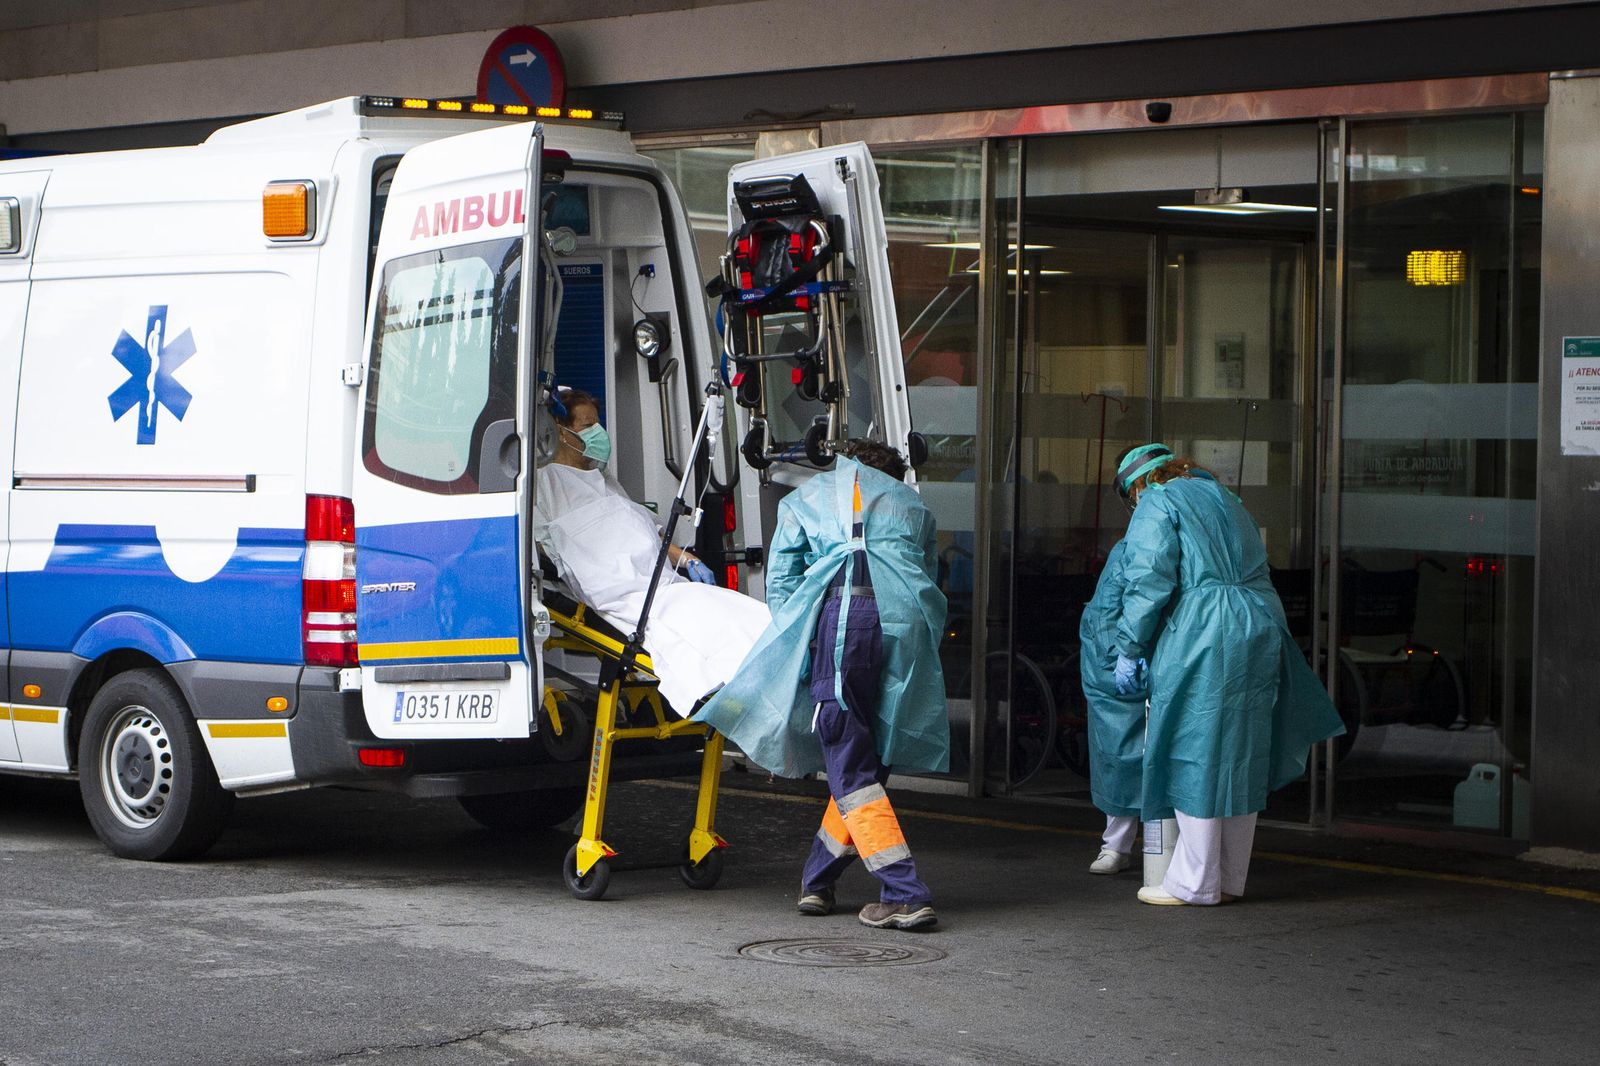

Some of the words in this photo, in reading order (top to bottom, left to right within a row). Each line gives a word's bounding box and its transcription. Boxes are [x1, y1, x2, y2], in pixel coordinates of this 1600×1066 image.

[410, 189, 525, 241] AMBUL
[563, 266, 591, 275] SUEROS
[1396, 456, 1409, 471] DE
[361, 582, 416, 594] SPRINTER
[406, 694, 451, 719] 0351
[456, 694, 494, 719] KRB
